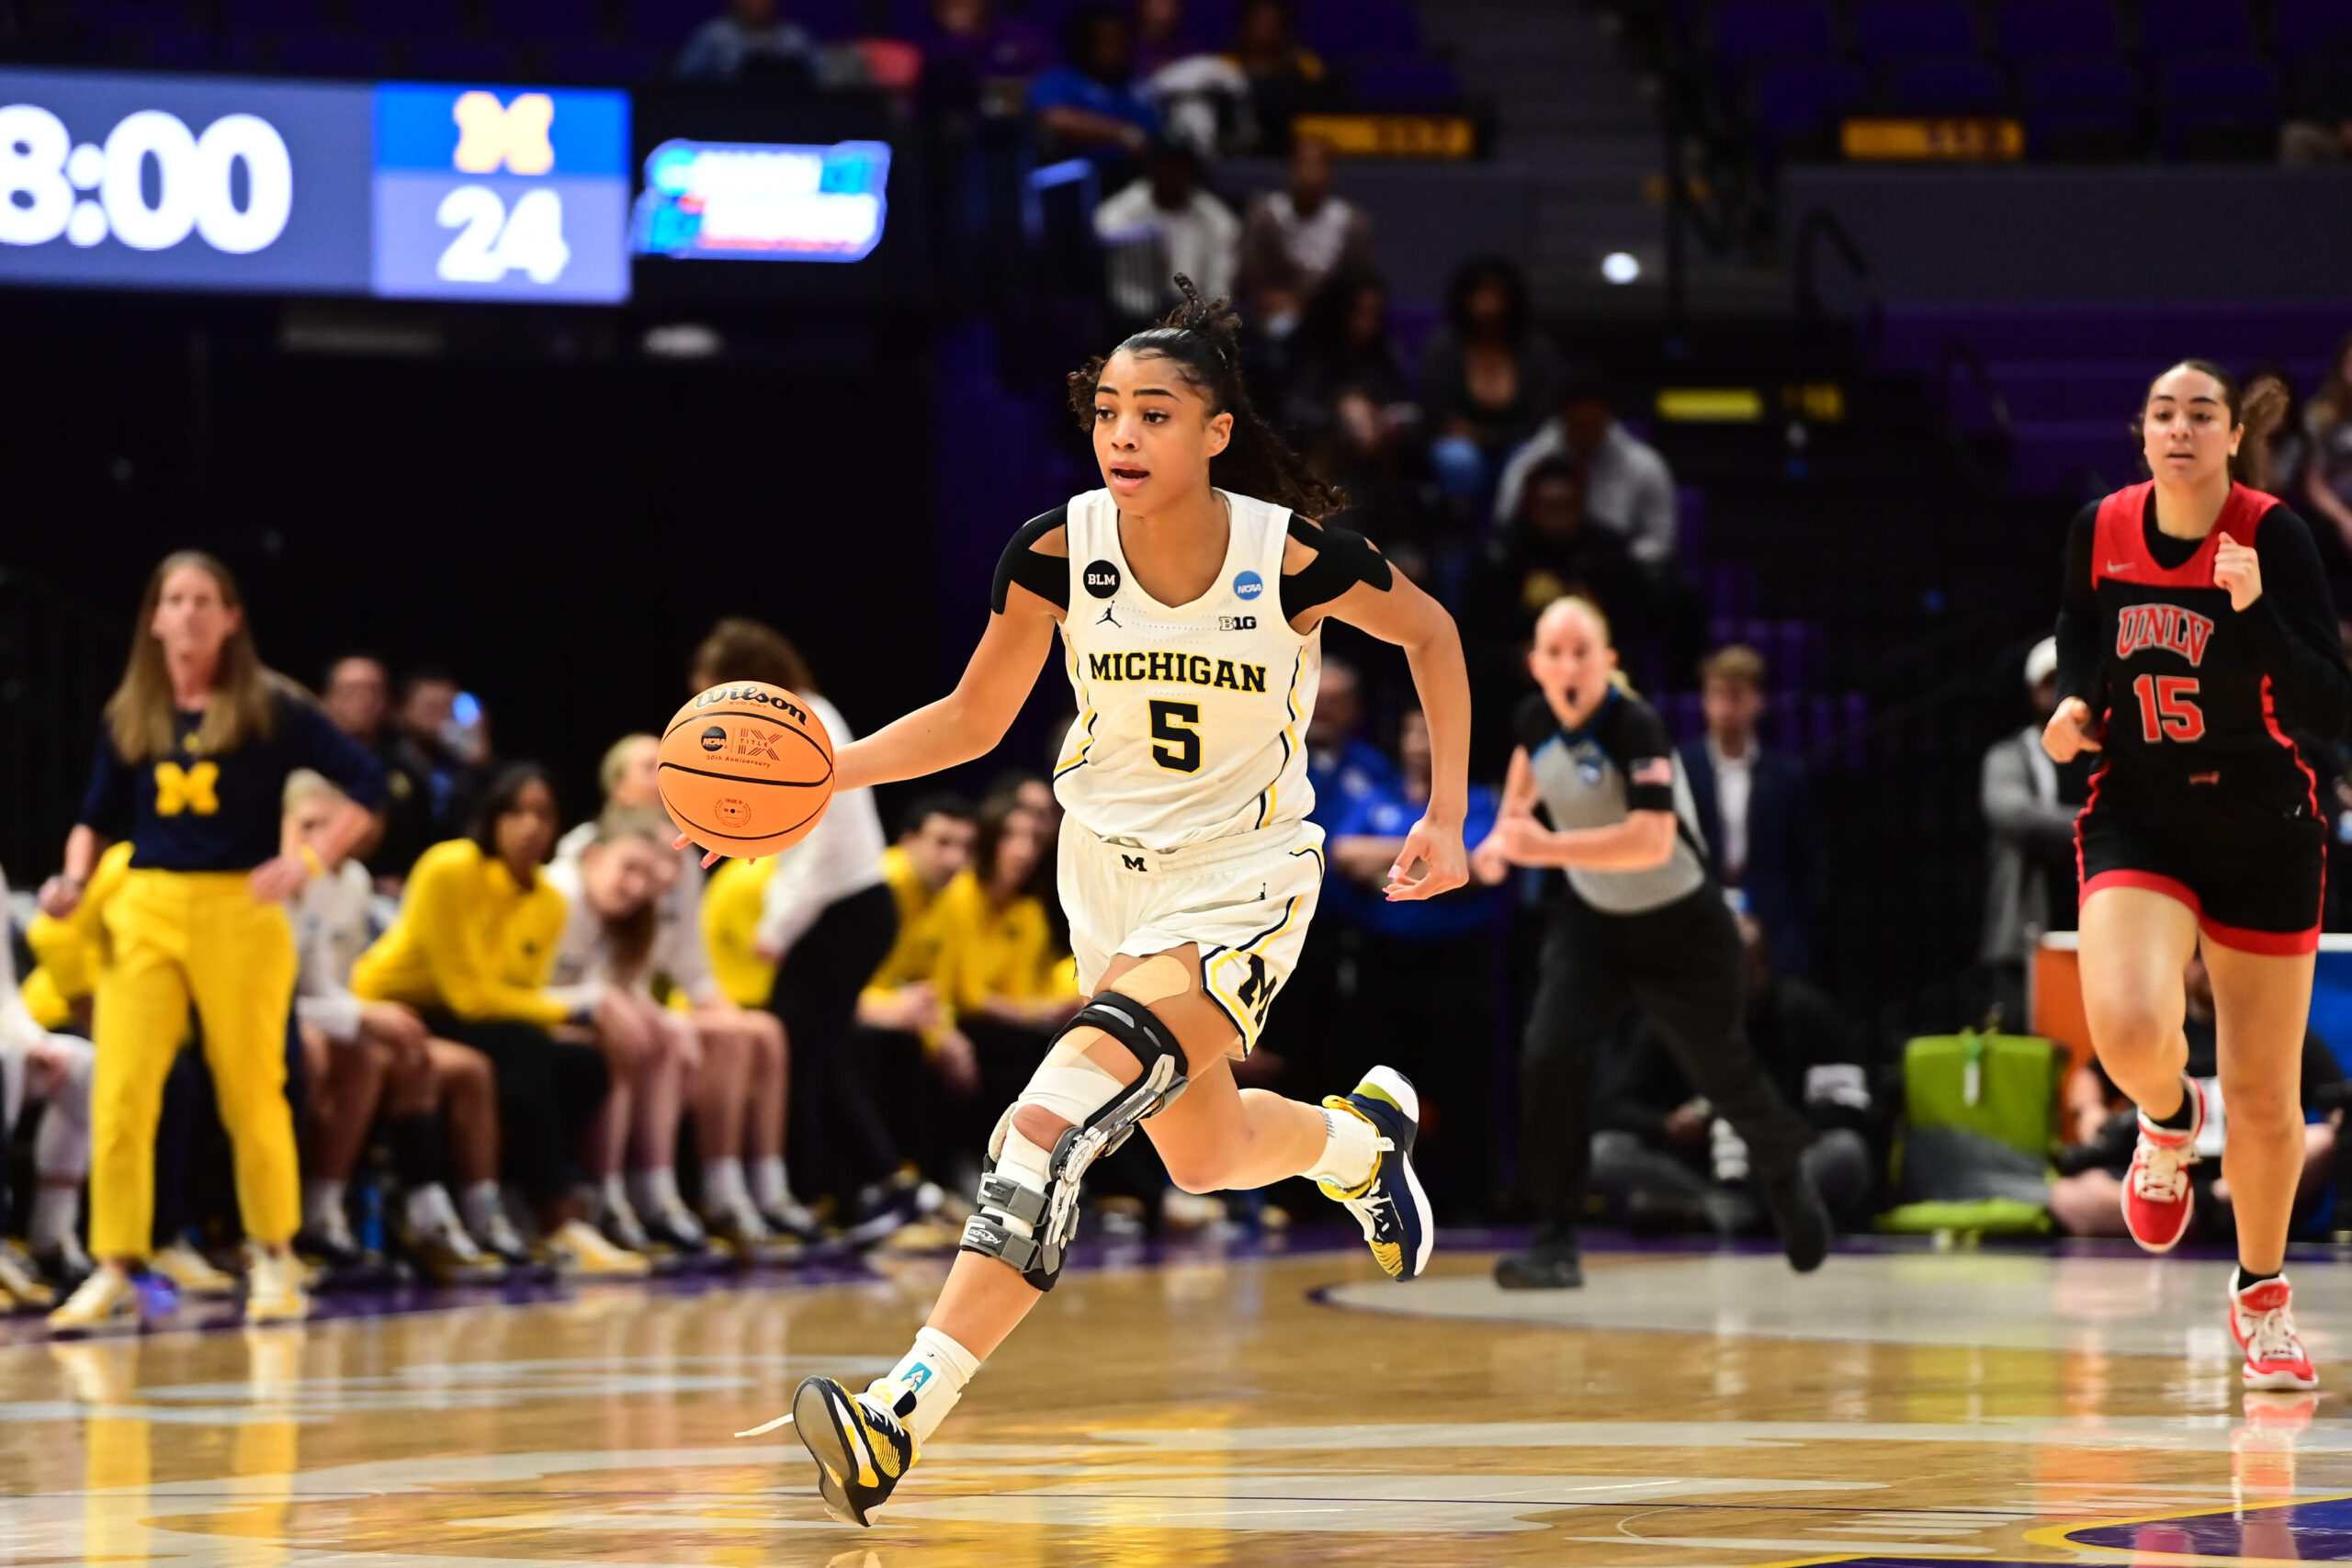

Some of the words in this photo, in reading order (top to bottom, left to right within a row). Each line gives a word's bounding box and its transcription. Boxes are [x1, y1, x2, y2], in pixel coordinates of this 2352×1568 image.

[435, 185, 571, 284] 24
[1088, 573, 1115, 586] BLM
[1237, 583, 1263, 594] NCAA
[2116, 603, 2214, 667] UNLV
[1088, 651, 1267, 694] MICHIGAN
[695, 686, 808, 727] Wilson
[2133, 673, 2205, 743] 15
[702, 738, 727, 746] NCAA
[740, 739, 768, 748] TITLE
[1148, 698, 1204, 774] 5
[724, 755, 772, 769] Anniversary
[1121, 853, 1148, 873] M
